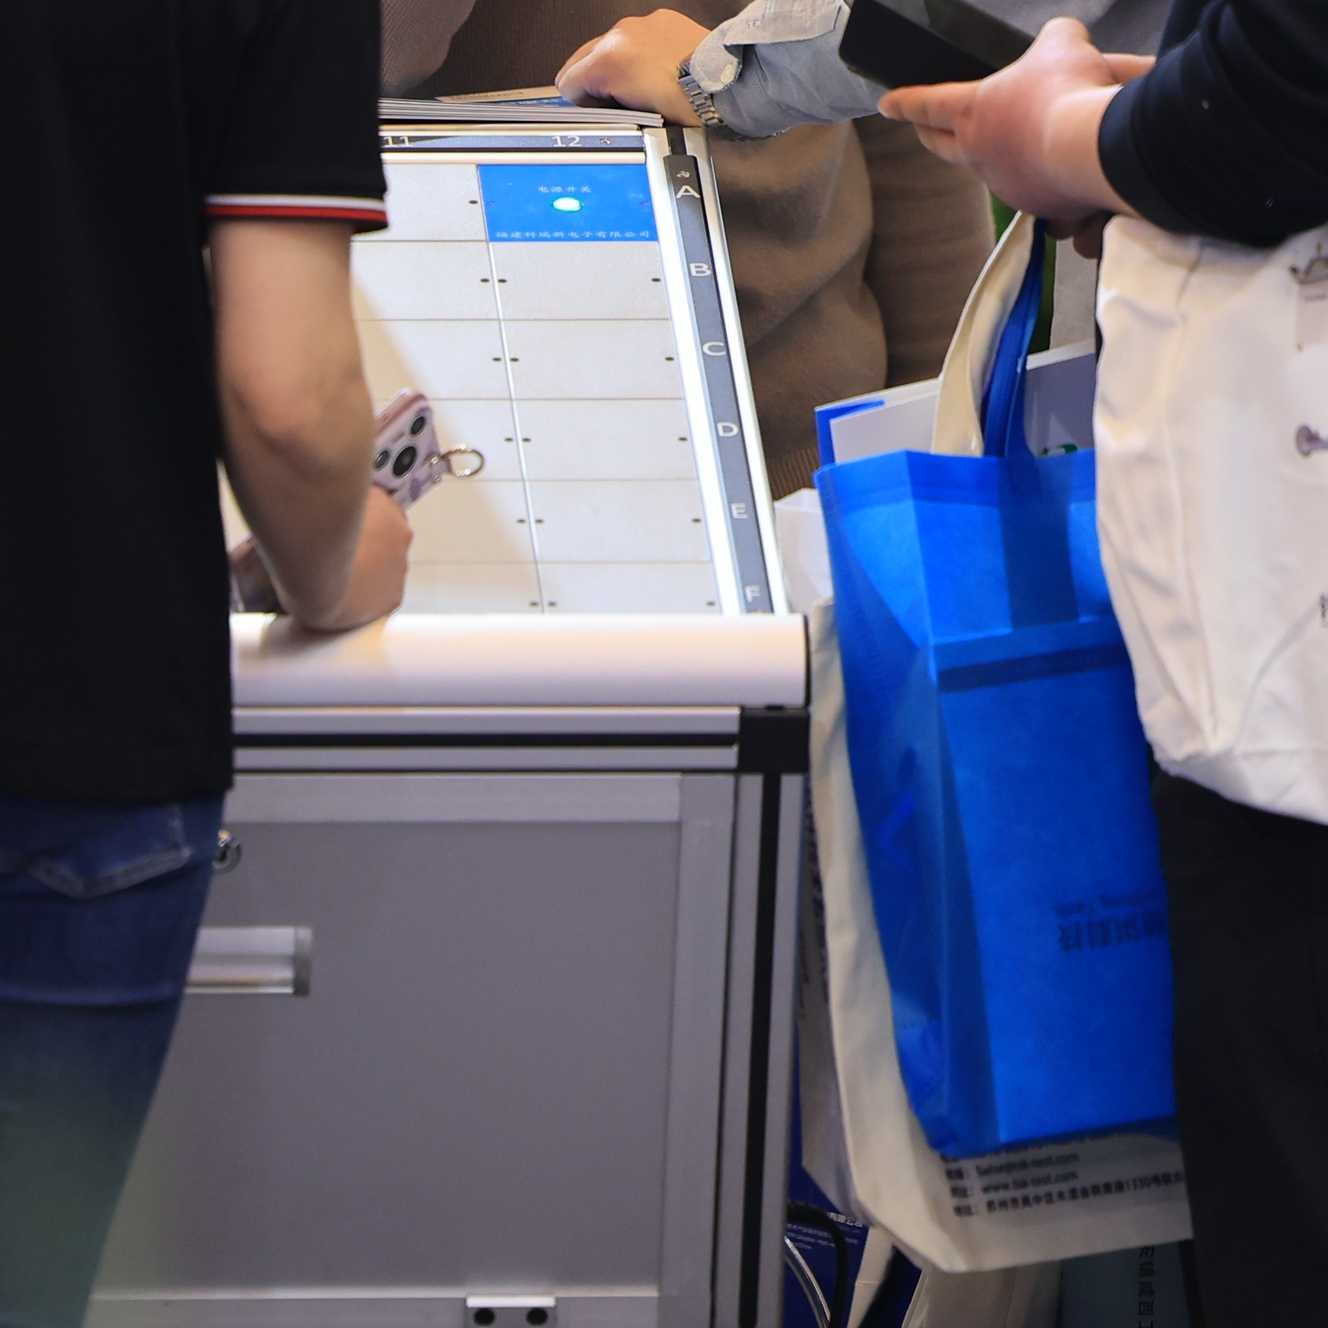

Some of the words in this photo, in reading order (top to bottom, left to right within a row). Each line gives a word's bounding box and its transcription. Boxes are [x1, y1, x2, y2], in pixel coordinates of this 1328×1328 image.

[383, 136, 412, 147] 11
[552, 135, 583, 147] 12
[676, 185, 701, 199] A
[689, 262, 712, 277] B
[702, 341, 727, 356] C
[717, 423, 739, 437] D
[731, 503, 749, 520] E
[745, 585, 761, 603] F
